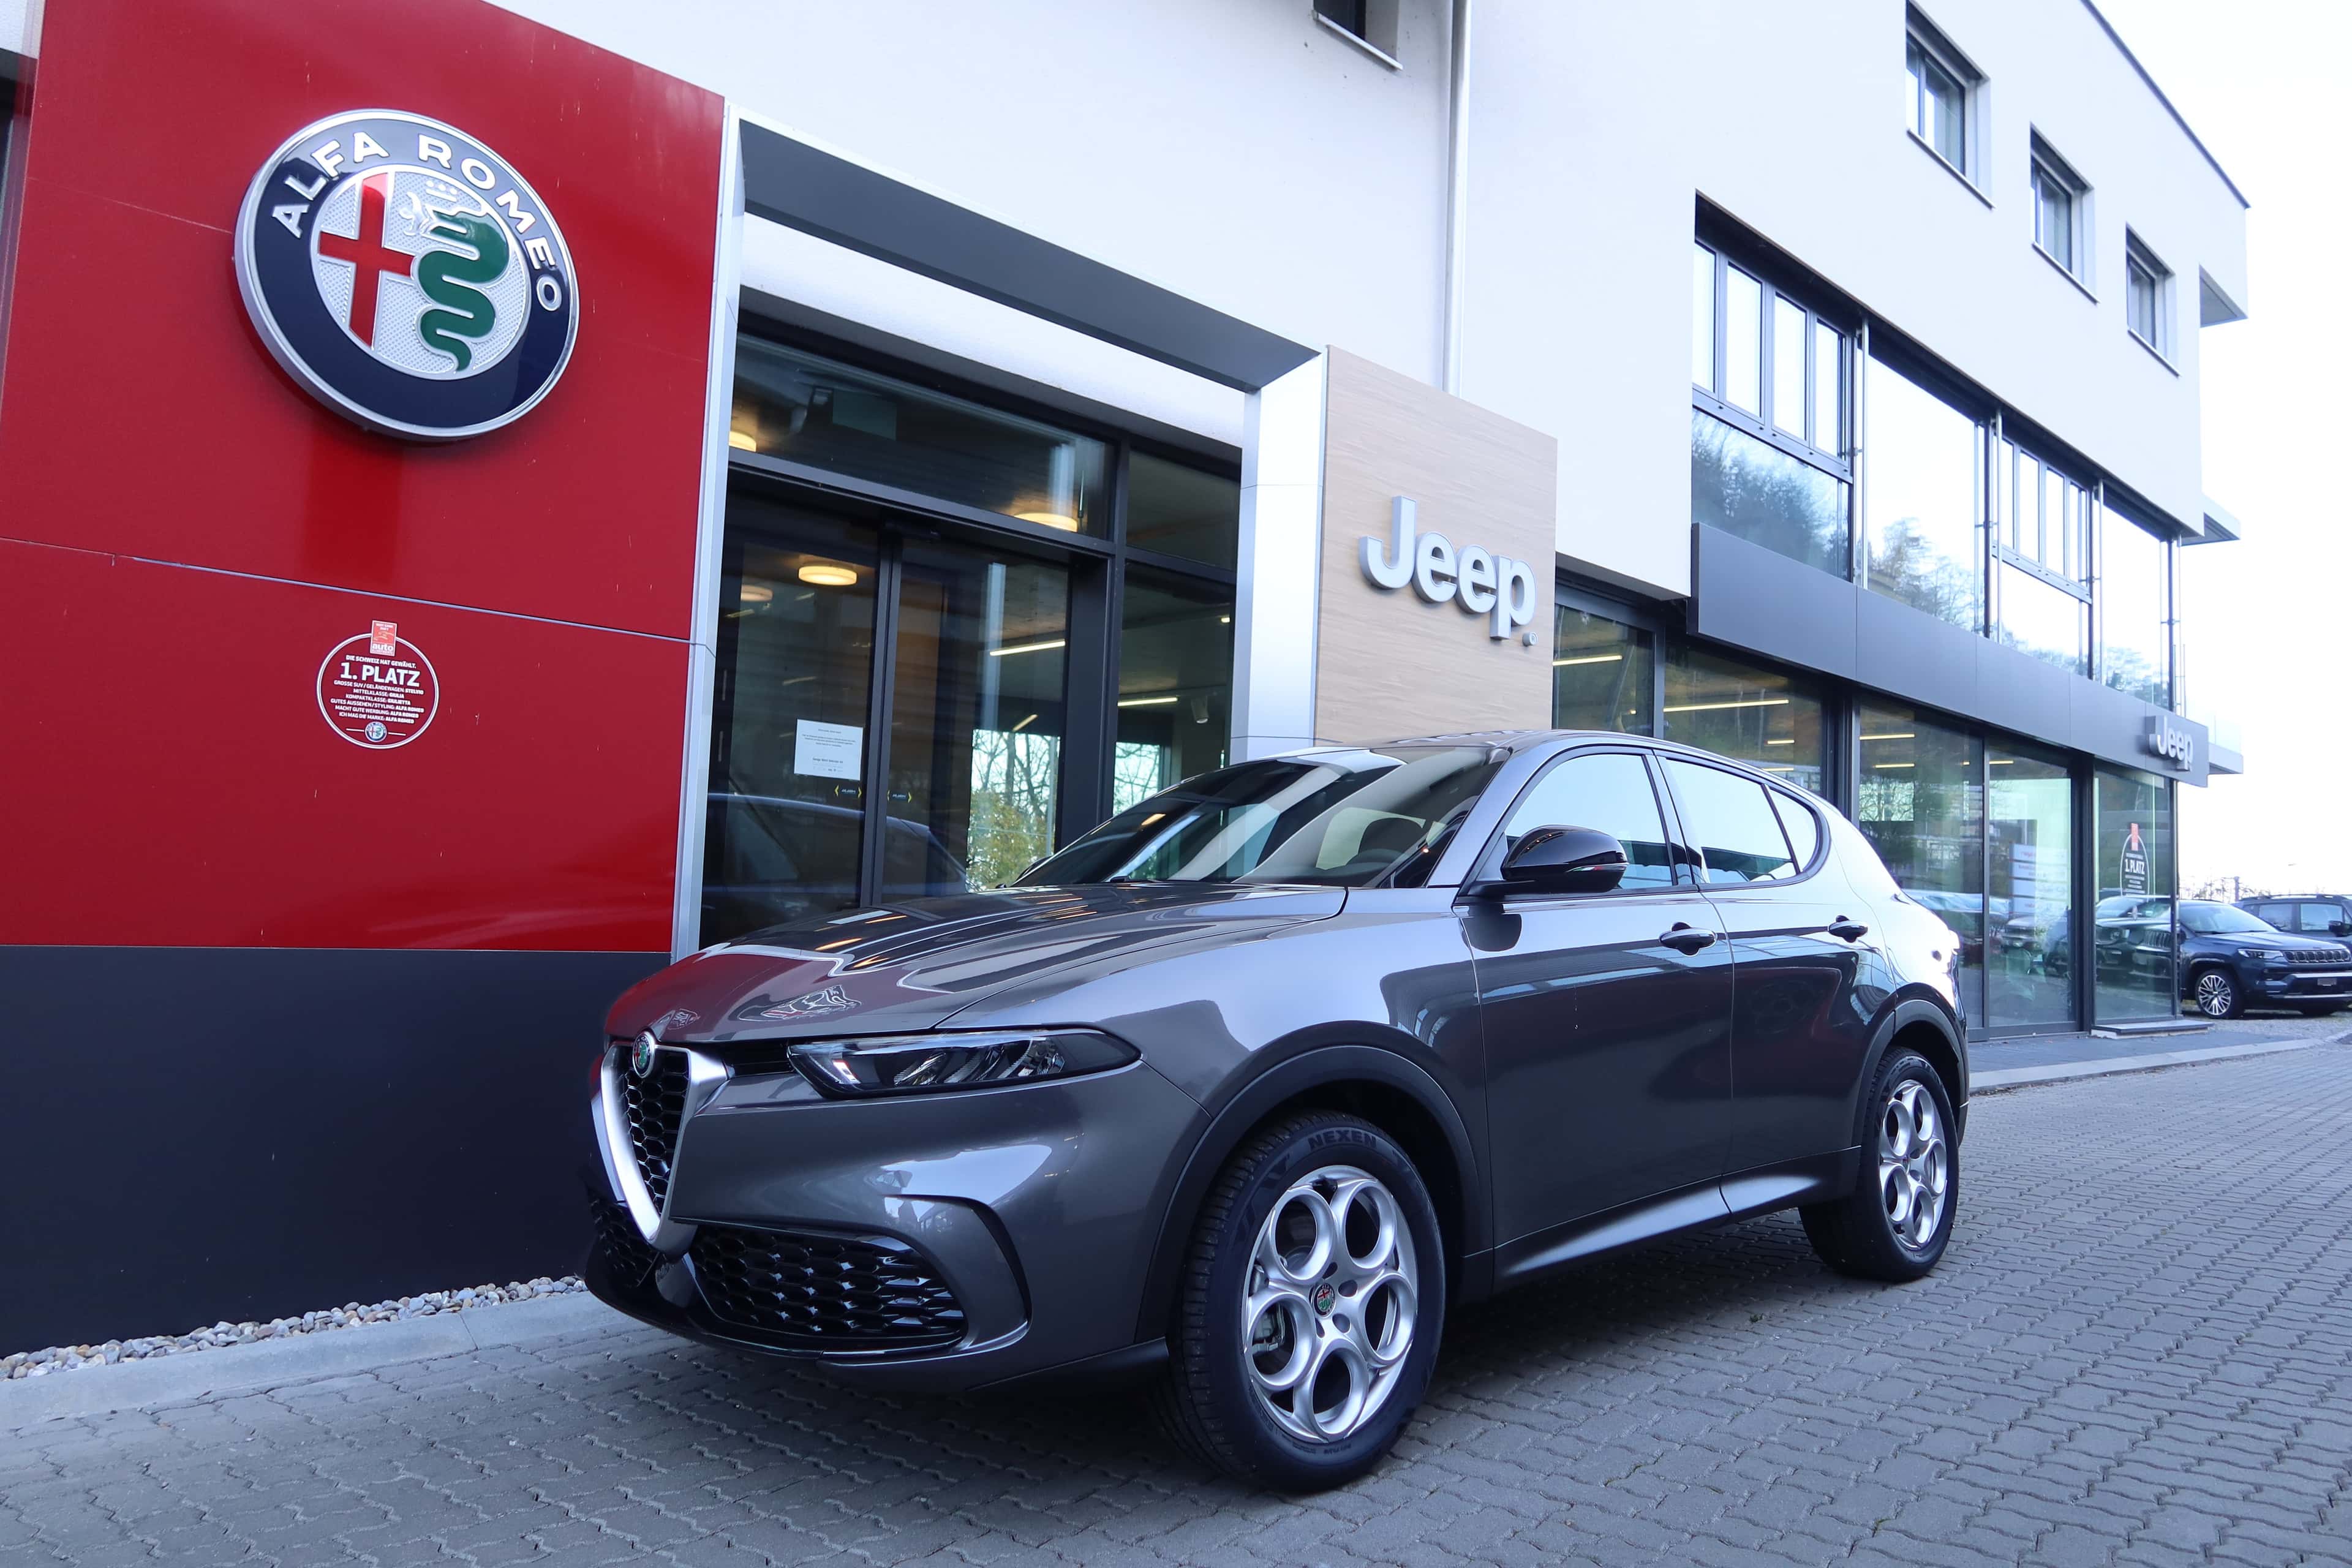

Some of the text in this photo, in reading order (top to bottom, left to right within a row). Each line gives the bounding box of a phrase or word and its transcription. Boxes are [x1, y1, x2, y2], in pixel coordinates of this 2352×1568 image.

[271, 132, 562, 312] ALFA ROMEO
[1359, 495, 1537, 639] Jeep
[356, 655, 380, 665] SCHWEIZ
[341, 662, 420, 687] 1. PLATZ
[2146, 715, 2193, 771] Jeep
[2130, 859, 2145, 875] PLATZ
[1308, 1129, 1377, 1150] NEXEN
